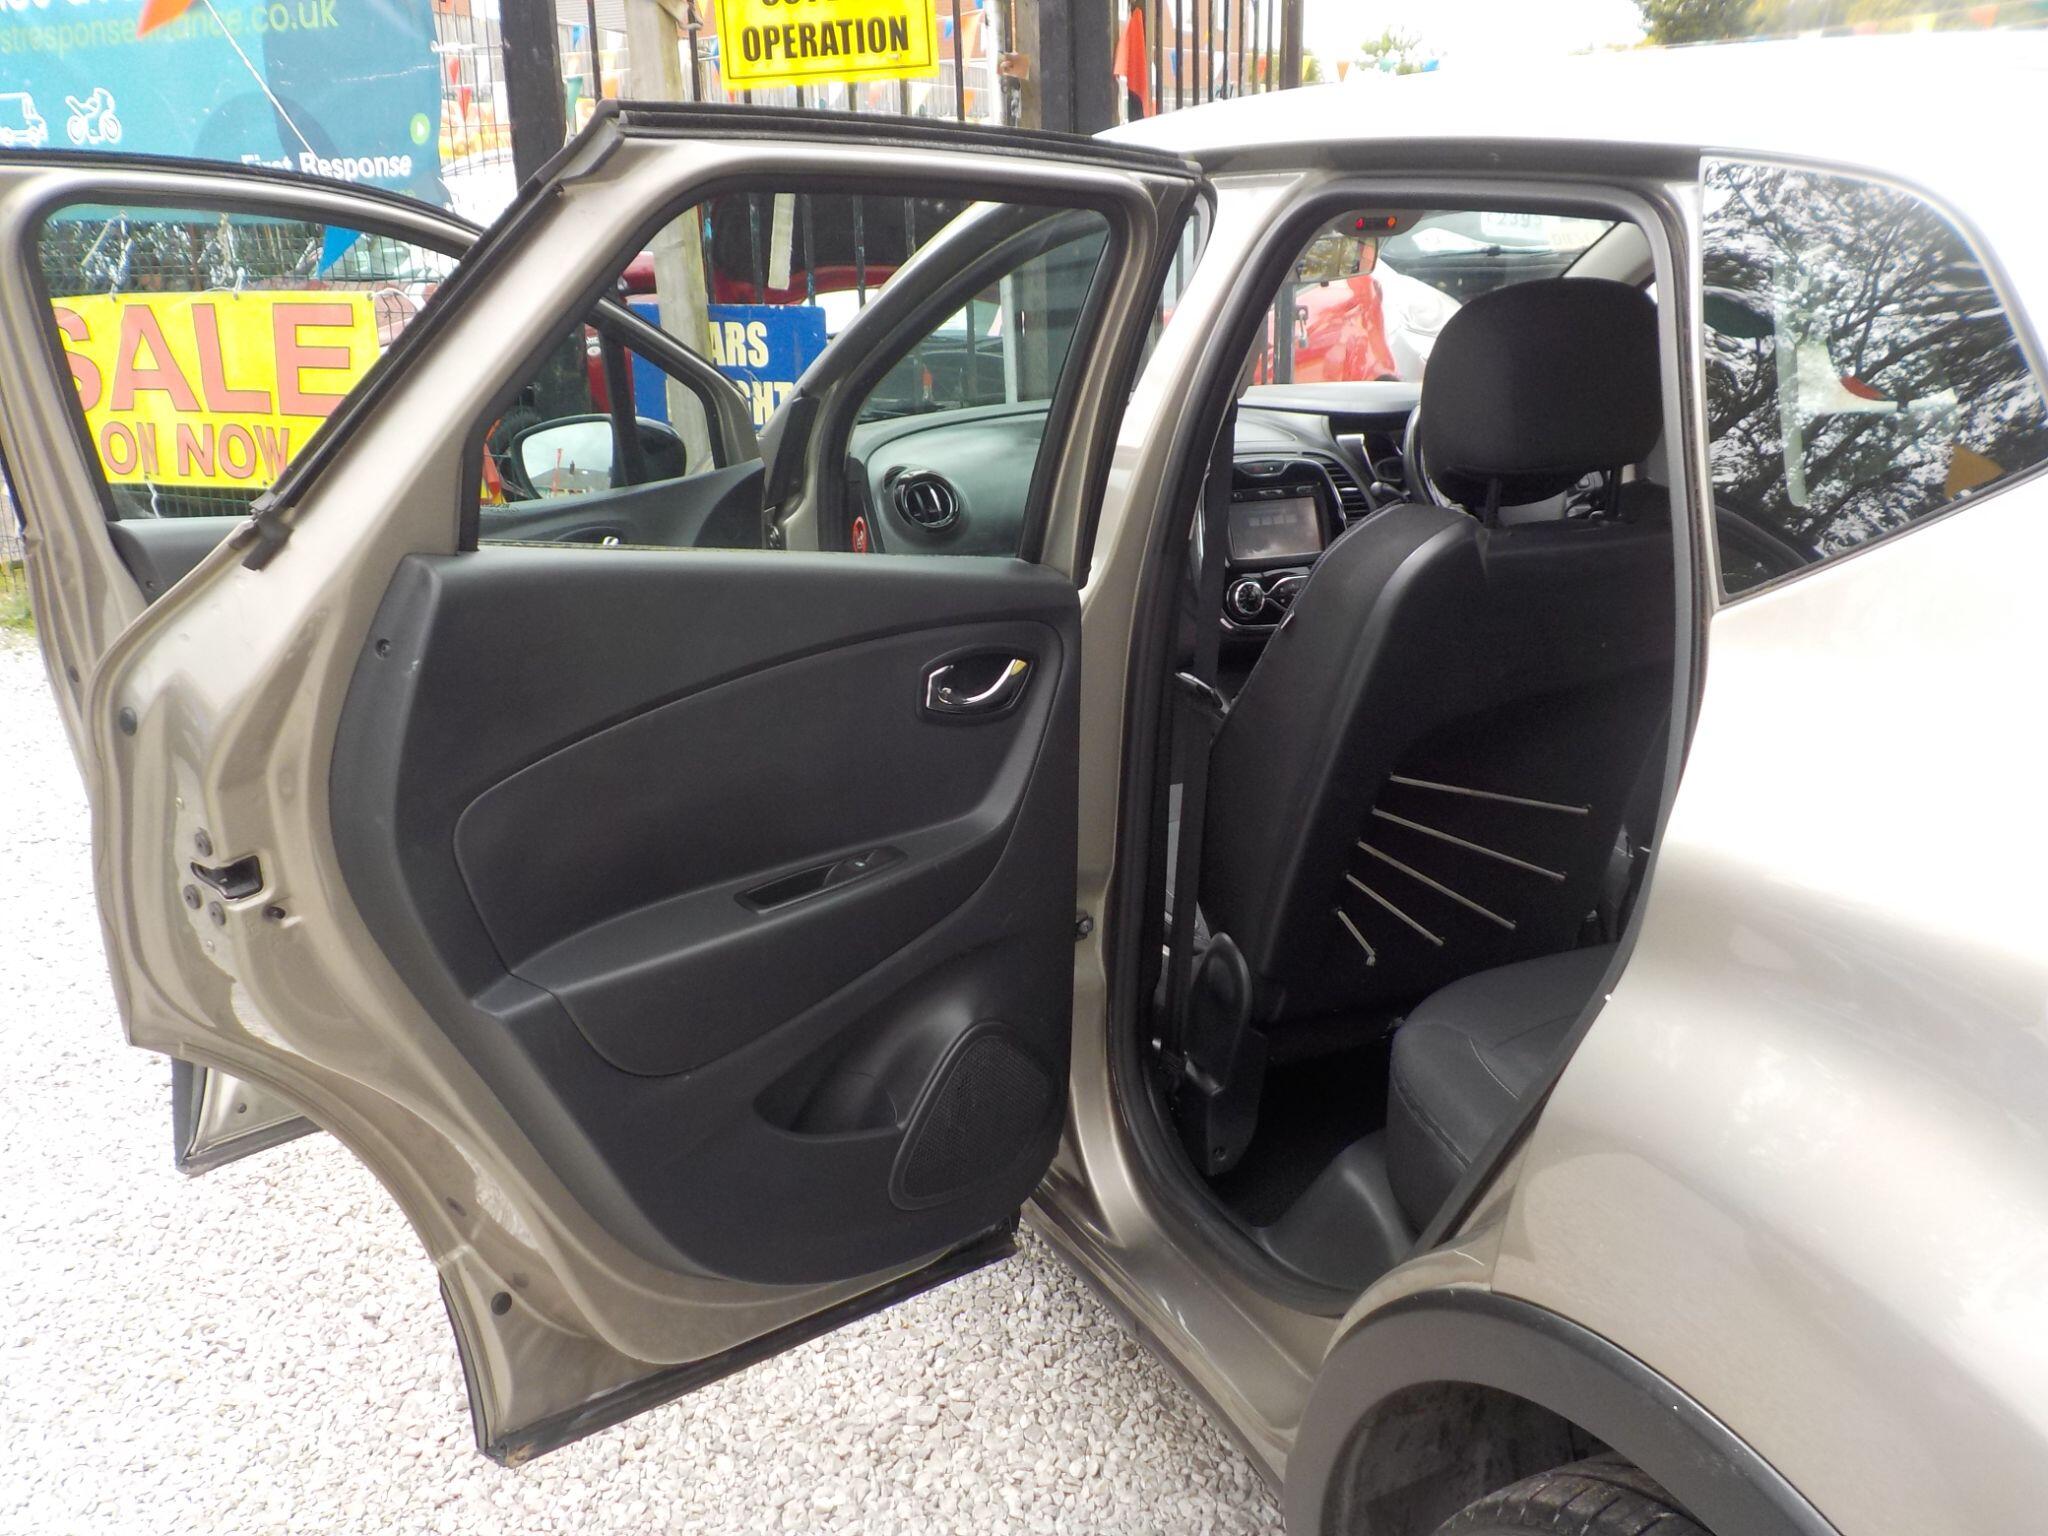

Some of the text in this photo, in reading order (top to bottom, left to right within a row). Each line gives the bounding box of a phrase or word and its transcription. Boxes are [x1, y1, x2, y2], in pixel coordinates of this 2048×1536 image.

[742, 15, 909, 62] OPERATION
[299, 152, 412, 182] Response
[56, 303, 354, 417] SALE
[708, 321, 769, 368] ARS
[100, 421, 290, 480] ON NOW
